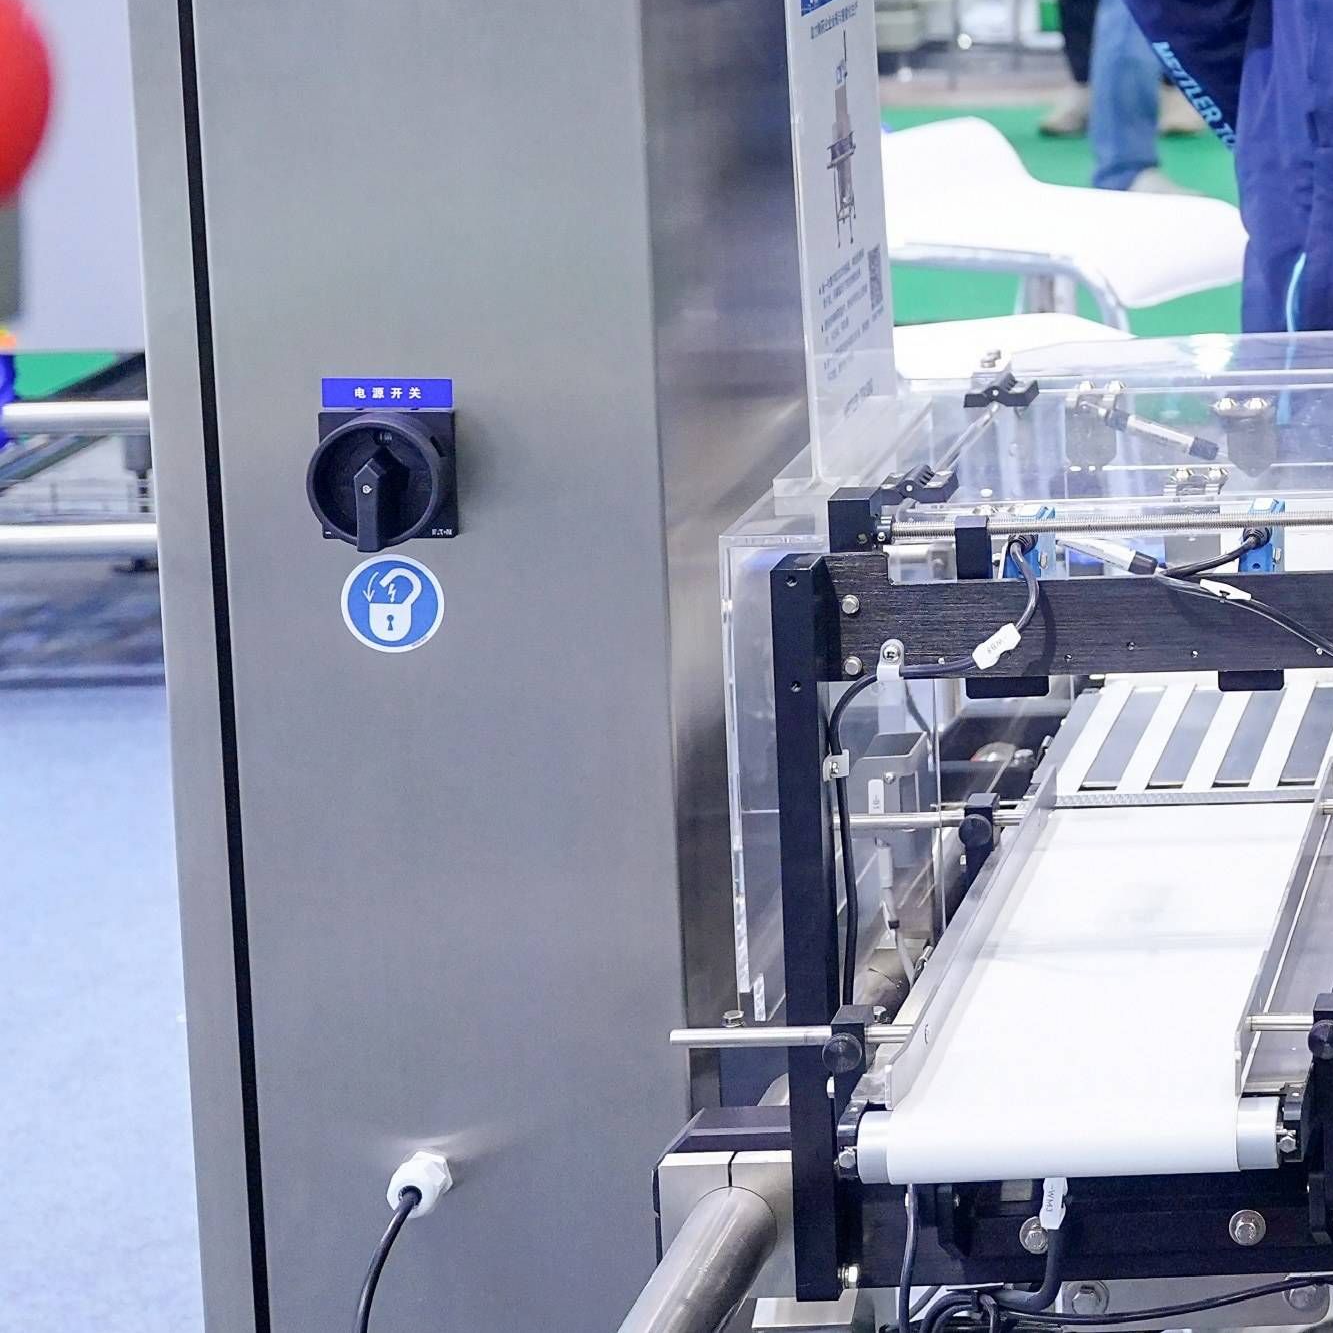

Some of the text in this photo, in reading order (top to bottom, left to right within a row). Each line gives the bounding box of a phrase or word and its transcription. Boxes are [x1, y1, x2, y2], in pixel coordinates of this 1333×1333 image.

[1152, 41, 1222, 123] METTLER
[354, 386, 422, 400] 电源开关
